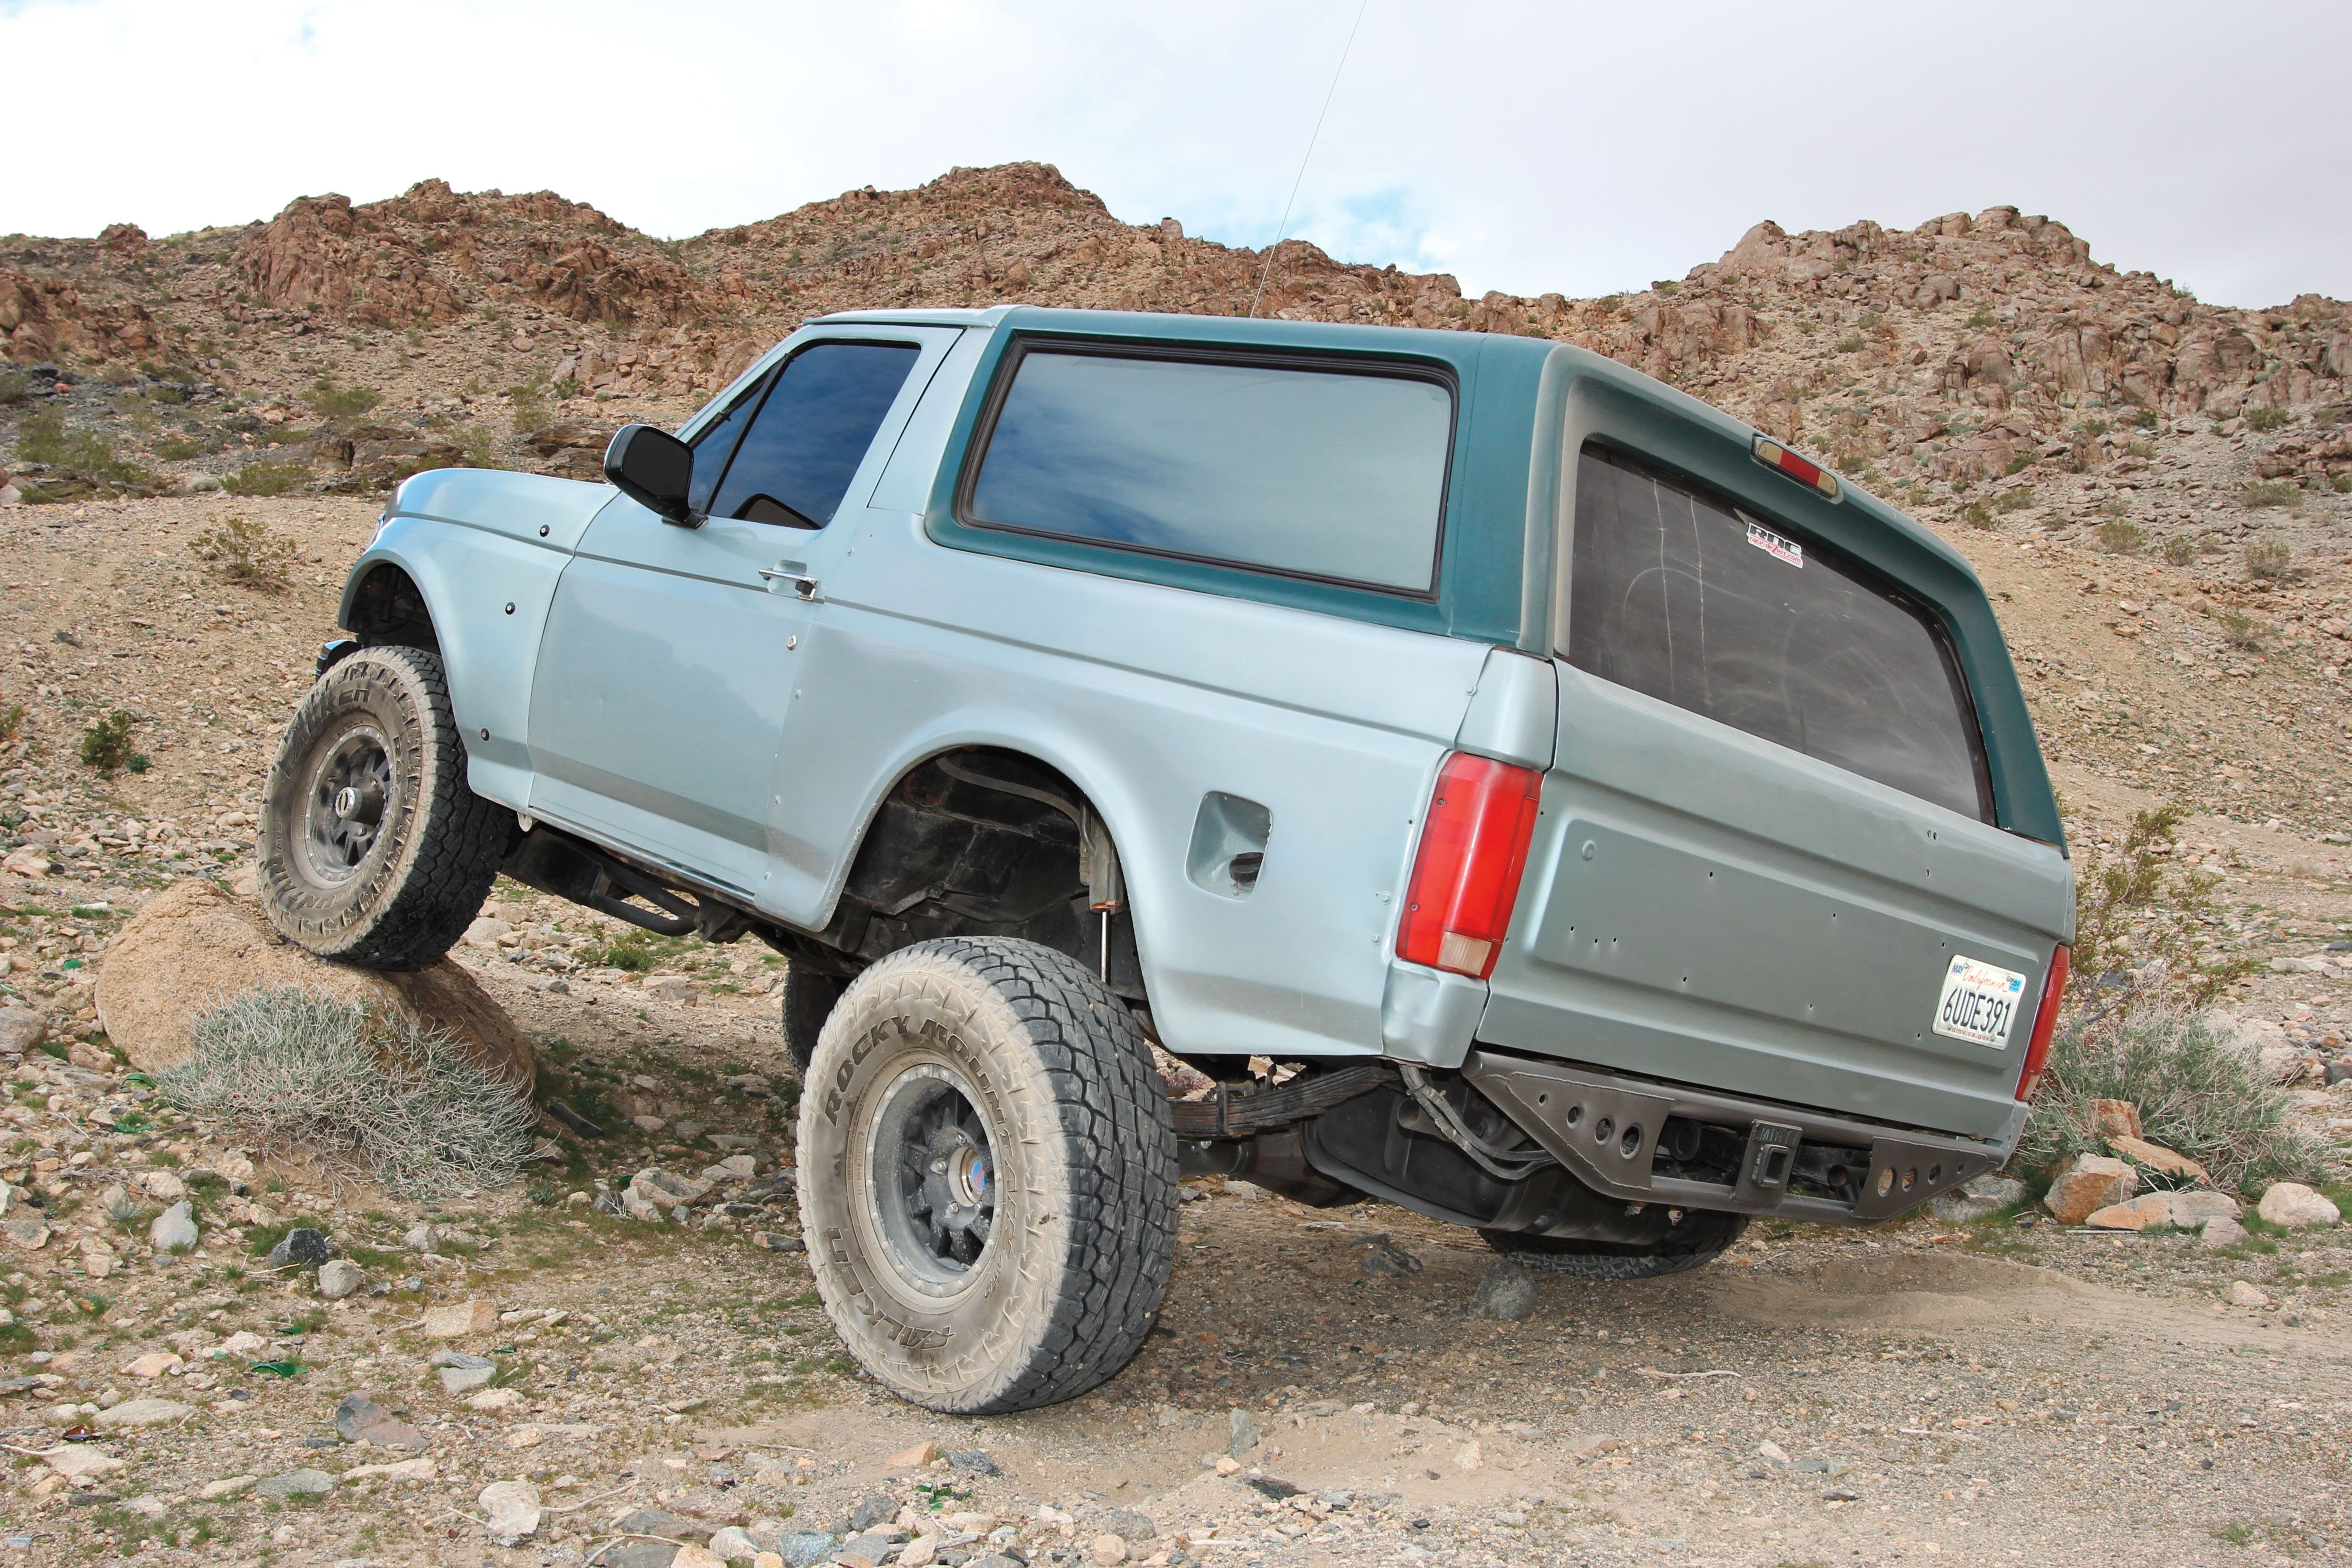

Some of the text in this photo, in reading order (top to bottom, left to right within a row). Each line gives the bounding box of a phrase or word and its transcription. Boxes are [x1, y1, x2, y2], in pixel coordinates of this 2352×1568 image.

[1750, 524, 1801, 557] RDC
[1951, 964, 1964, 975] MAY
[1963, 965, 2008, 992] California
[1943, 987, 2011, 1037] 6UDE391
[1952, 1028, 1990, 1040] dmv.ca.gov
[825, 1014, 911, 1128] ROCKY
[918, 1017, 1017, 1259] MOUNTAIN
[1759, 1127, 1801, 1145] MINTY
[826, 1227, 956, 1351] FALKEN
